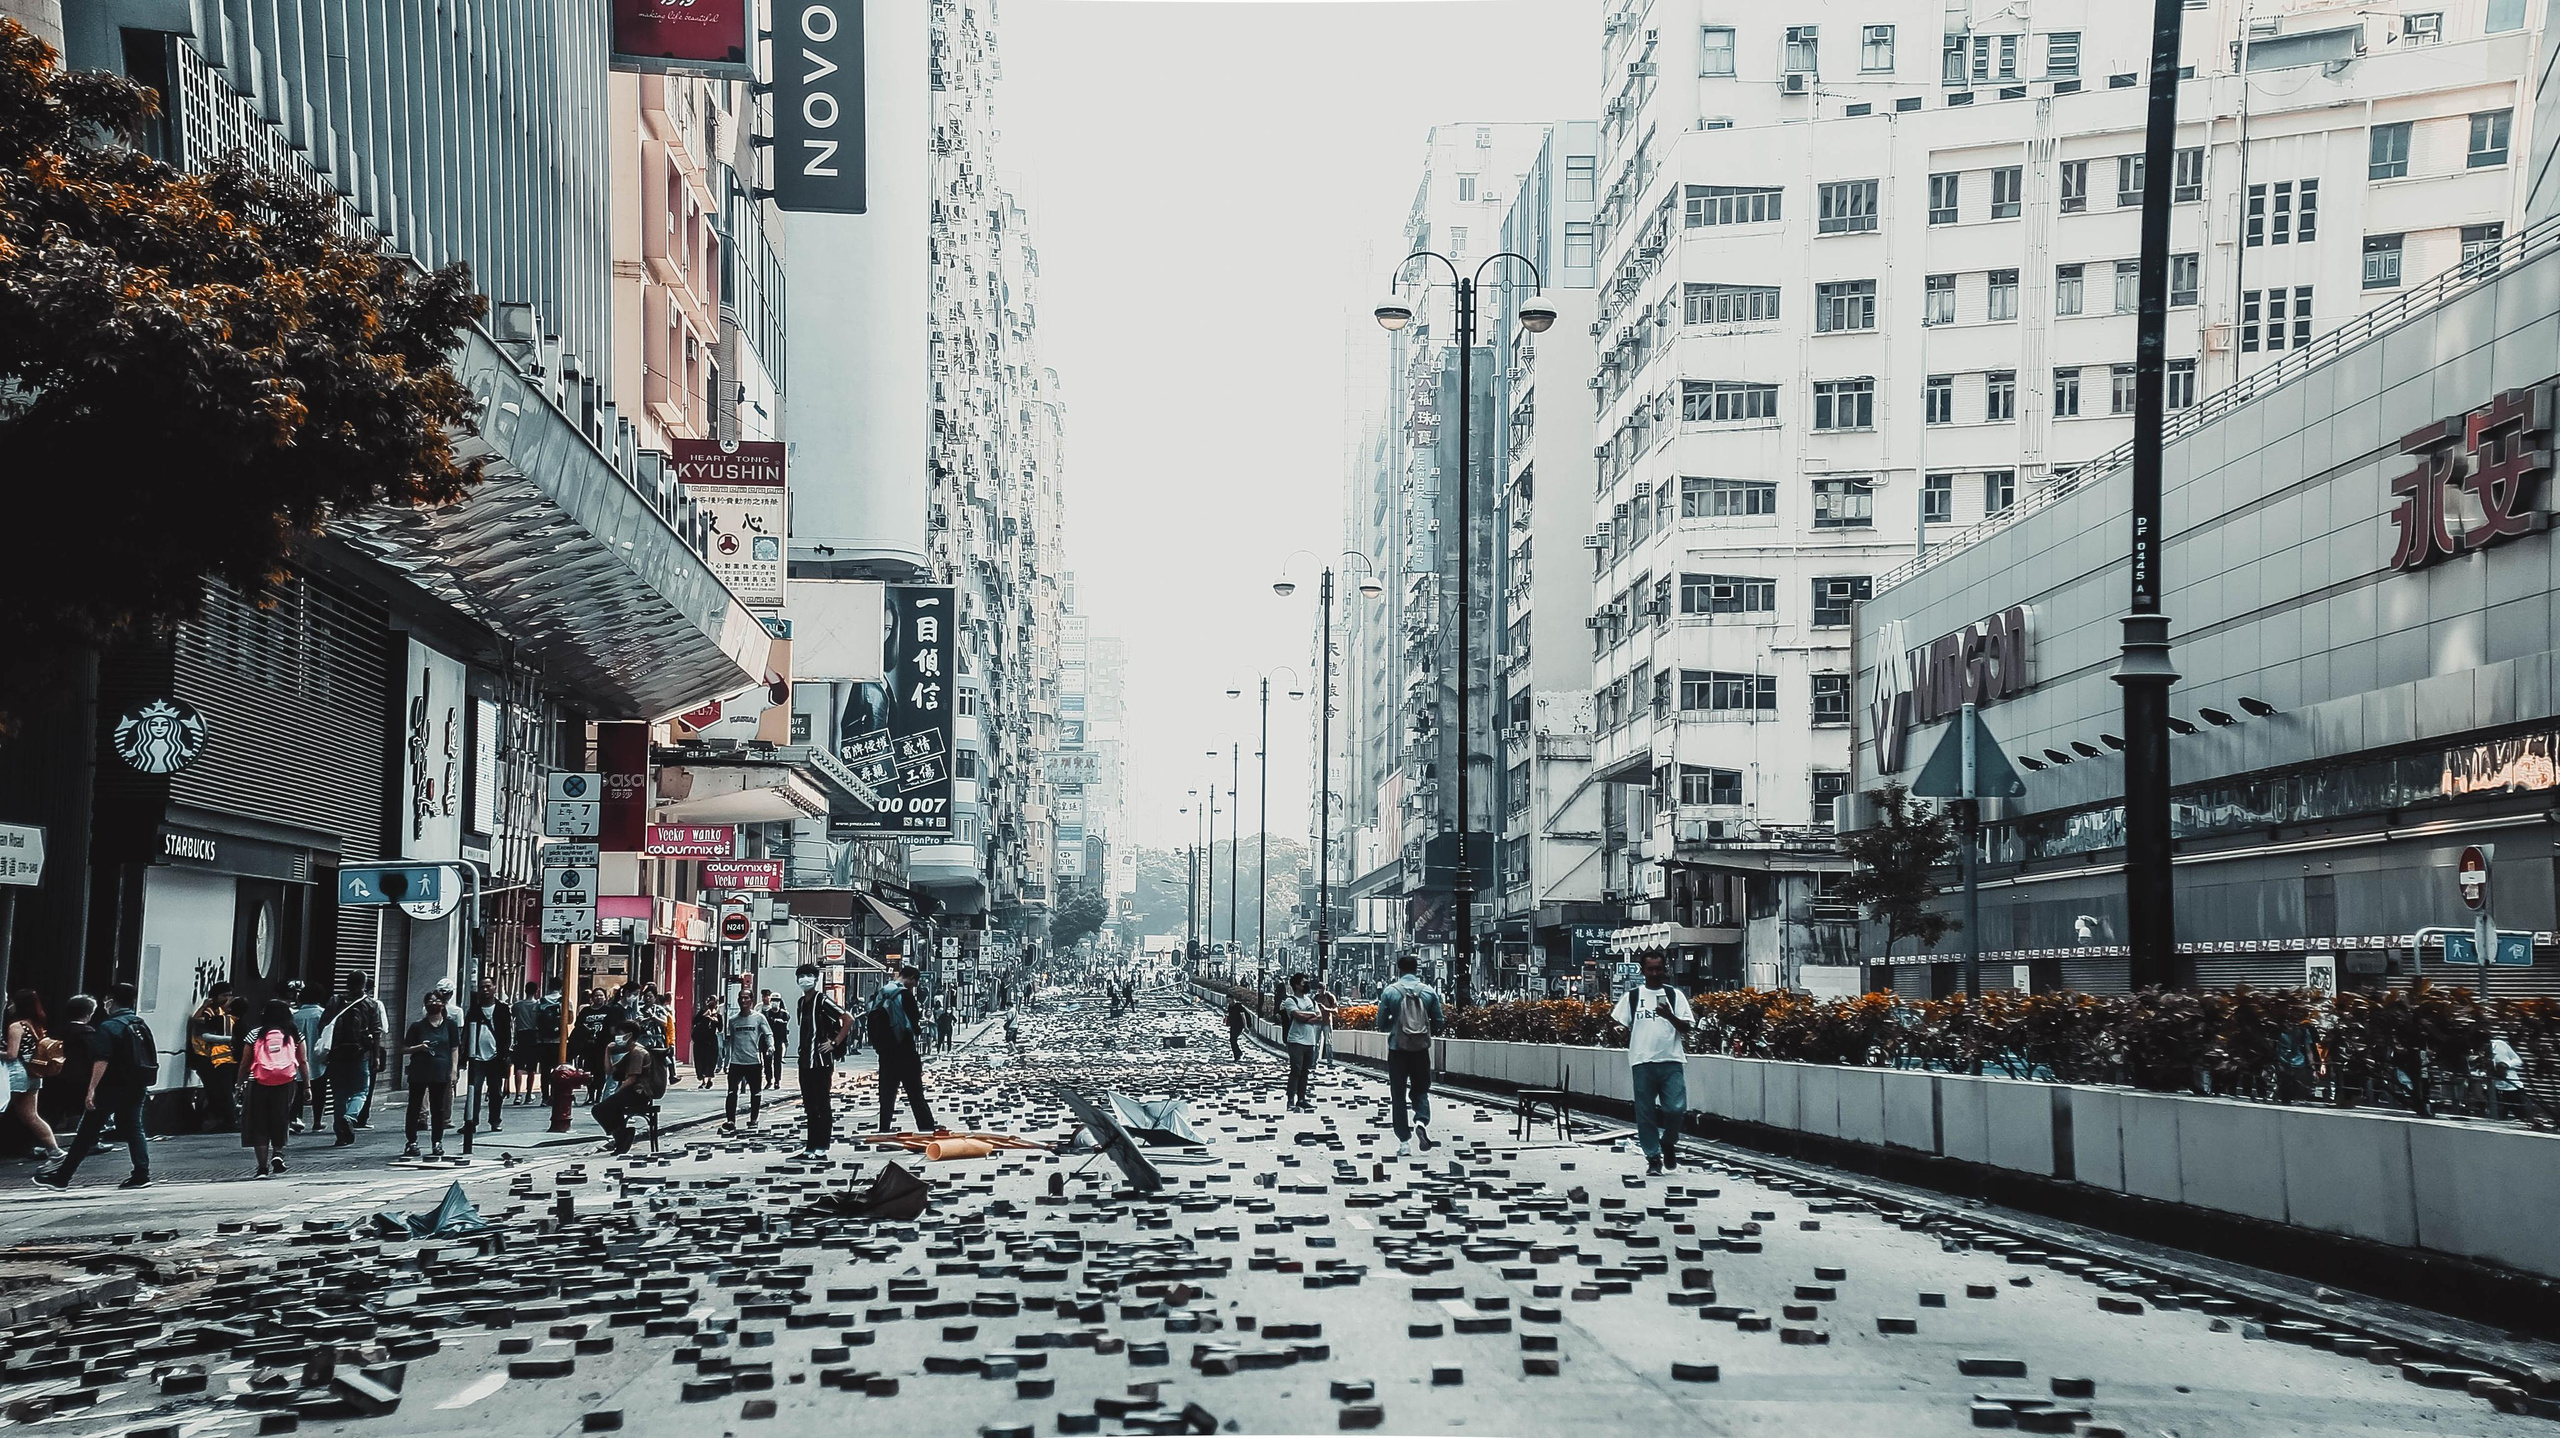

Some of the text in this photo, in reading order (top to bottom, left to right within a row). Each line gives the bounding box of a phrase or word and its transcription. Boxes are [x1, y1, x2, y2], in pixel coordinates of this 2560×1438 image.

[667, 11, 683, 24] life
[801, 4, 840, 177] NOVO
[690, 454, 770, 464] HEART TONIC
[678, 463, 780, 481] KYUSHIN
[2391, 386, 2545, 571] 永安
[2135, 517, 2148, 593] DF 0445 A
[911, 598, 941, 711] 一目偵信
[903, 735, 931, 757] 感情
[861, 763, 888, 781] 尋親
[906, 763, 935, 782] 工傷
[581, 804, 591, 816] 7
[908, 797, 947, 813] 007
[580, 823, 590, 834] 7
[692, 828, 723, 843] wanko
[164, 833, 216, 862] STARBUCKS
[898, 835, 940, 845] VisionPro
[743, 876, 769, 888] wanko
[551, 909, 586, 922] 上午 7
[575, 928, 592, 941] 12
[726, 923, 745, 931] N241
